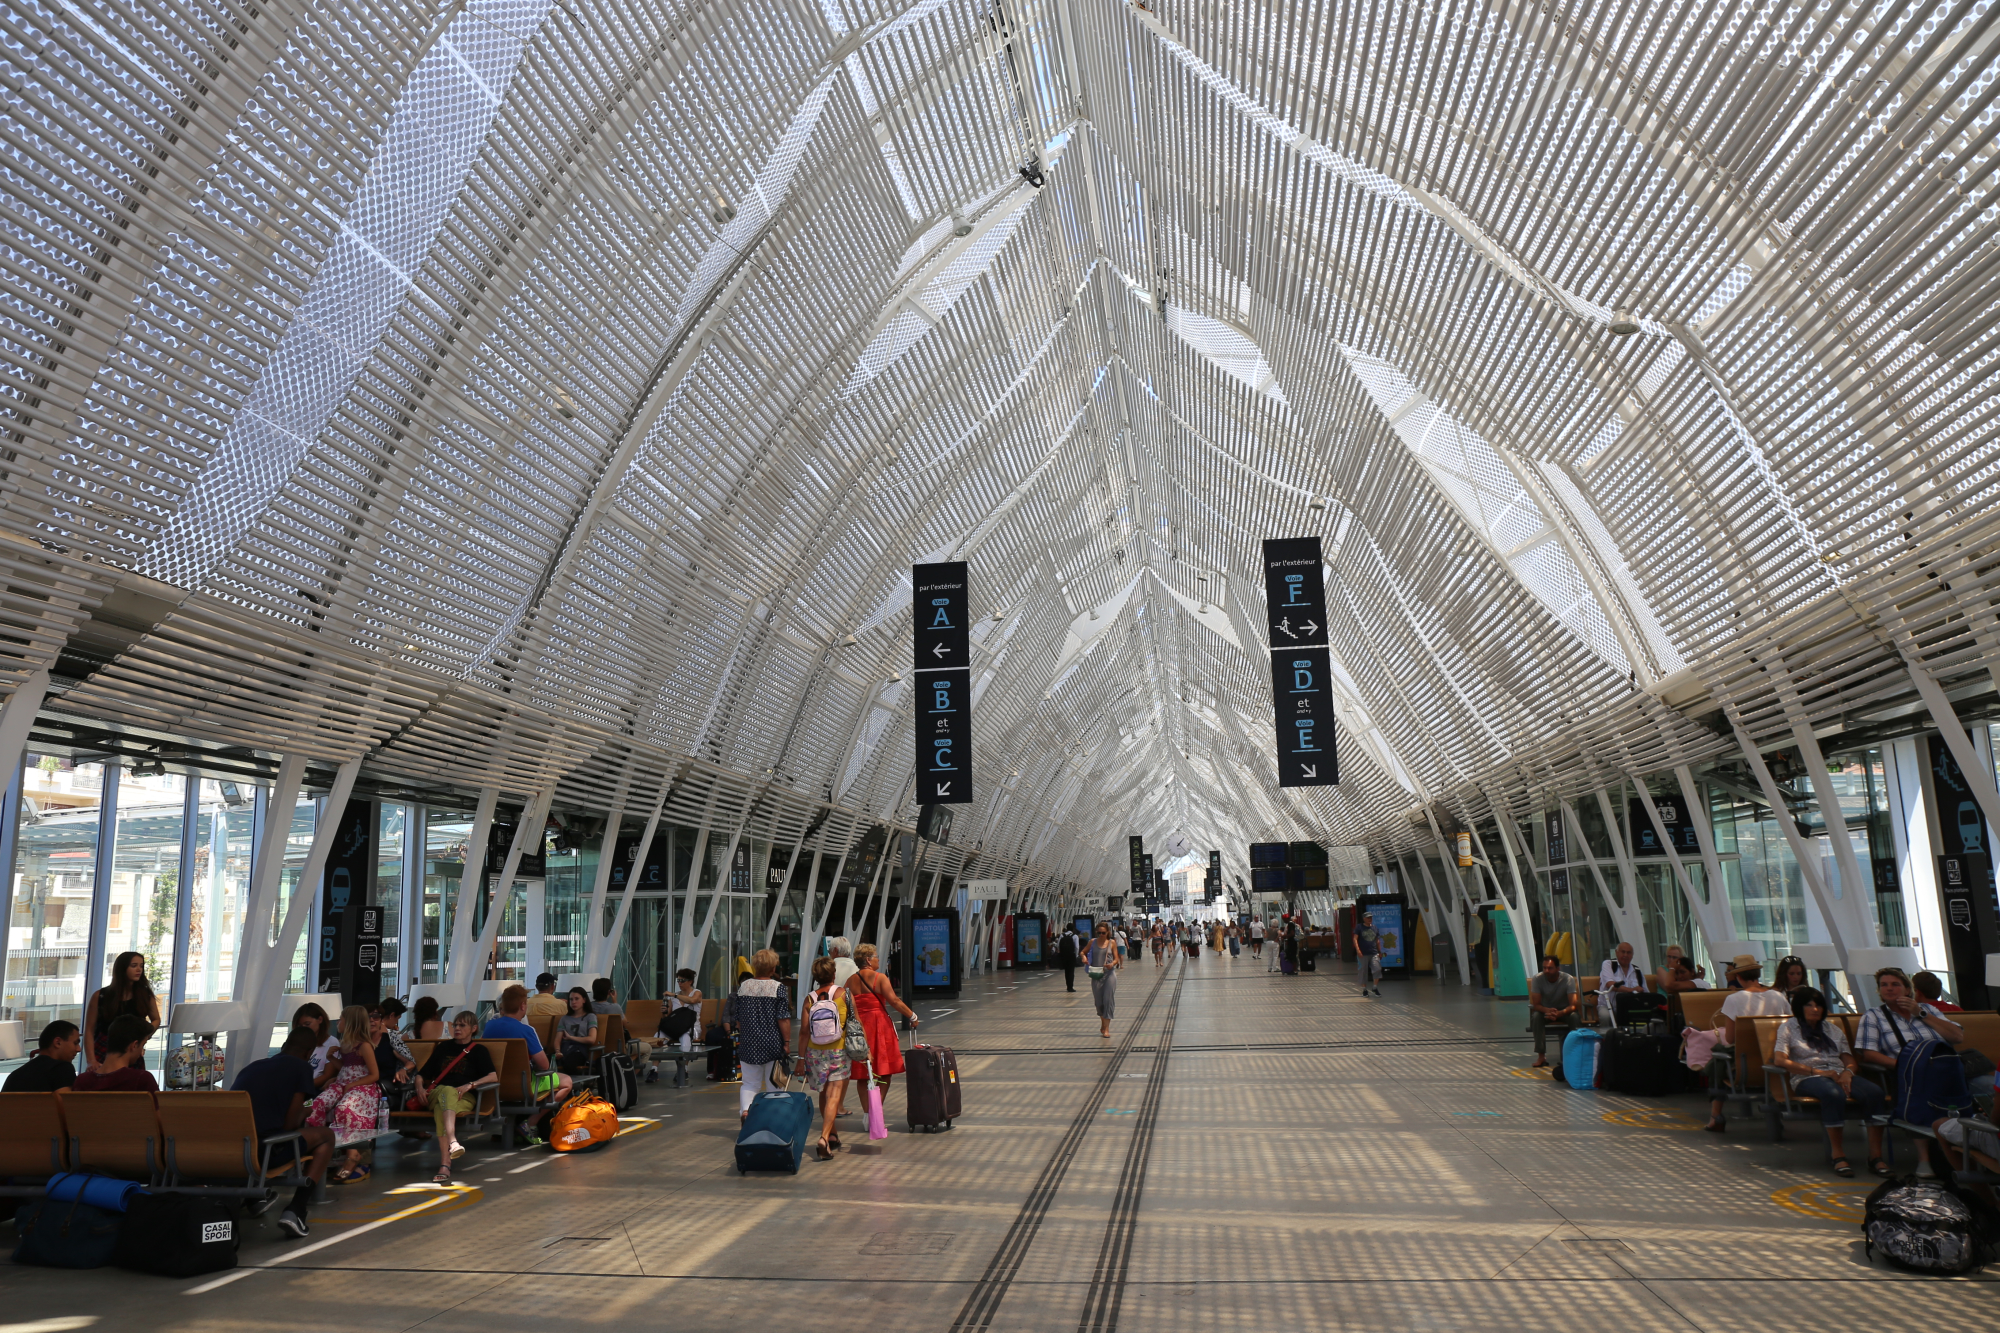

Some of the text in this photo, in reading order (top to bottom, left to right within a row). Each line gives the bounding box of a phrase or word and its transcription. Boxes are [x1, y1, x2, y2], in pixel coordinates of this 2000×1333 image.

[1283, 559, 1316, 567] l'extérieur
[930, 583, 962, 591] l'extérieur
[1289, 584, 1303, 602] F
[933, 607, 950, 626] A
[1294, 669, 1313, 689] D
[935, 690, 950, 709] B
[1297, 698, 1310, 708] et
[937, 718, 949, 727] et
[1298, 729, 1314, 749] E
[936, 748, 952, 767] C
[1686, 833, 1695, 844] E
[650, 871, 659, 881] C
[322, 938, 334, 962] B
[205, 1222, 230, 1232] CASAL
[205, 1231, 230, 1240] SPORT
[1906, 1235, 1923, 1243] THE
[1892, 1239, 1923, 1251] NORTH
[1901, 1247, 1923, 1260] FACE
